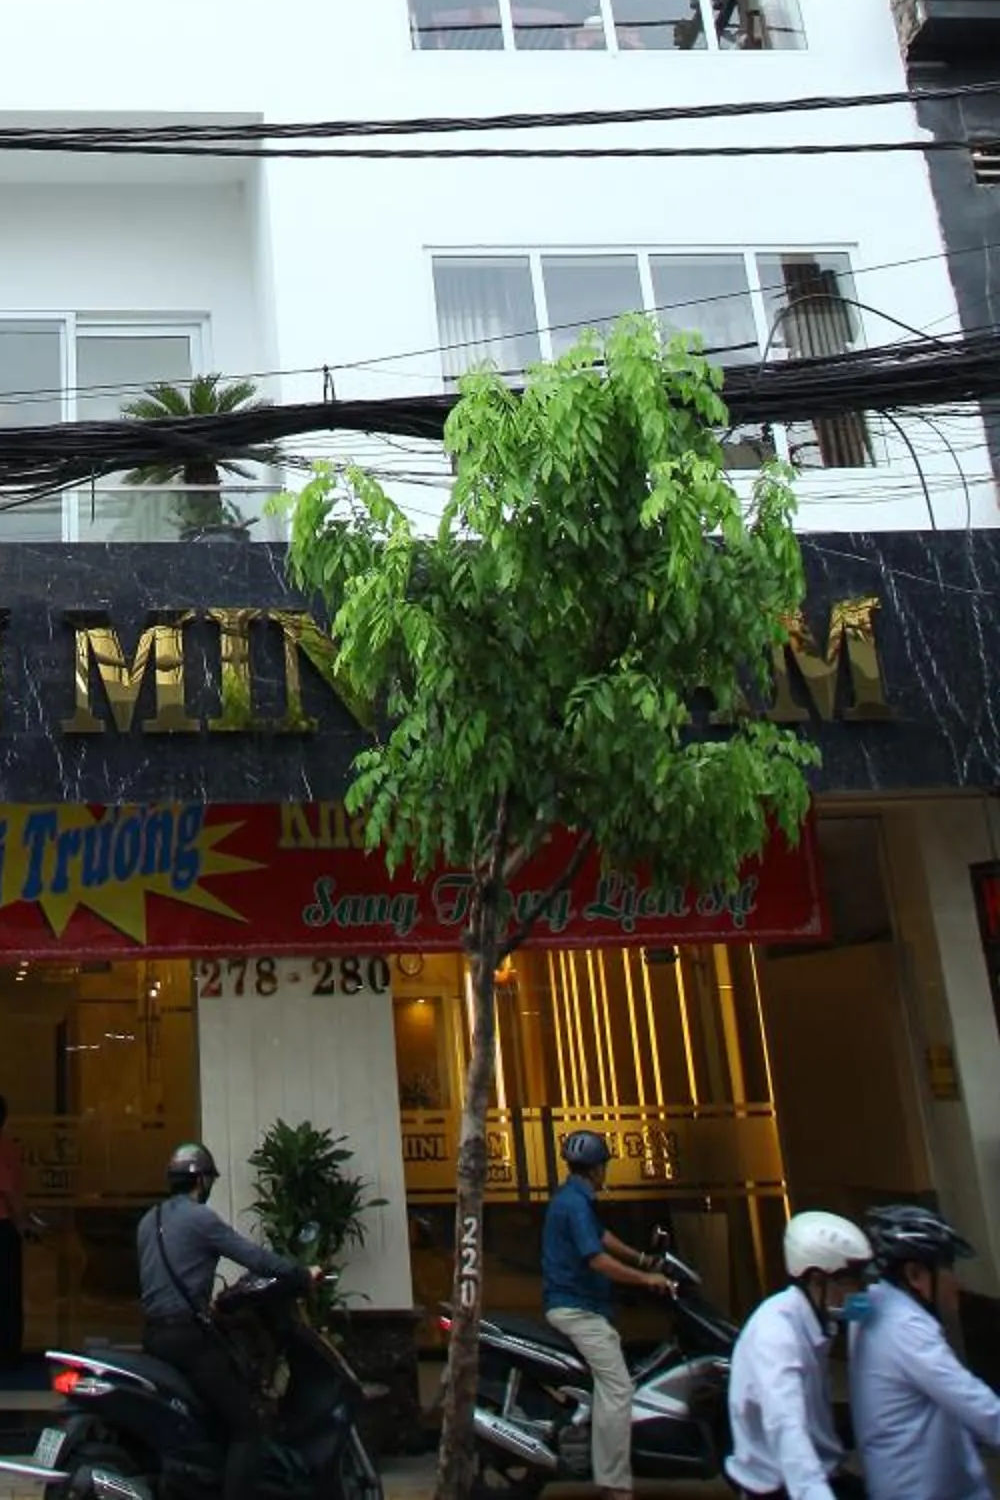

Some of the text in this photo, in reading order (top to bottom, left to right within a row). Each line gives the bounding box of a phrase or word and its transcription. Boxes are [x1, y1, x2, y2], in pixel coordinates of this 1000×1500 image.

[61, 607, 379, 733] MIN
[301, 872, 422, 936] Sang
[199, 956, 278, 998] 278
[311, 955, 391, 995] 280
